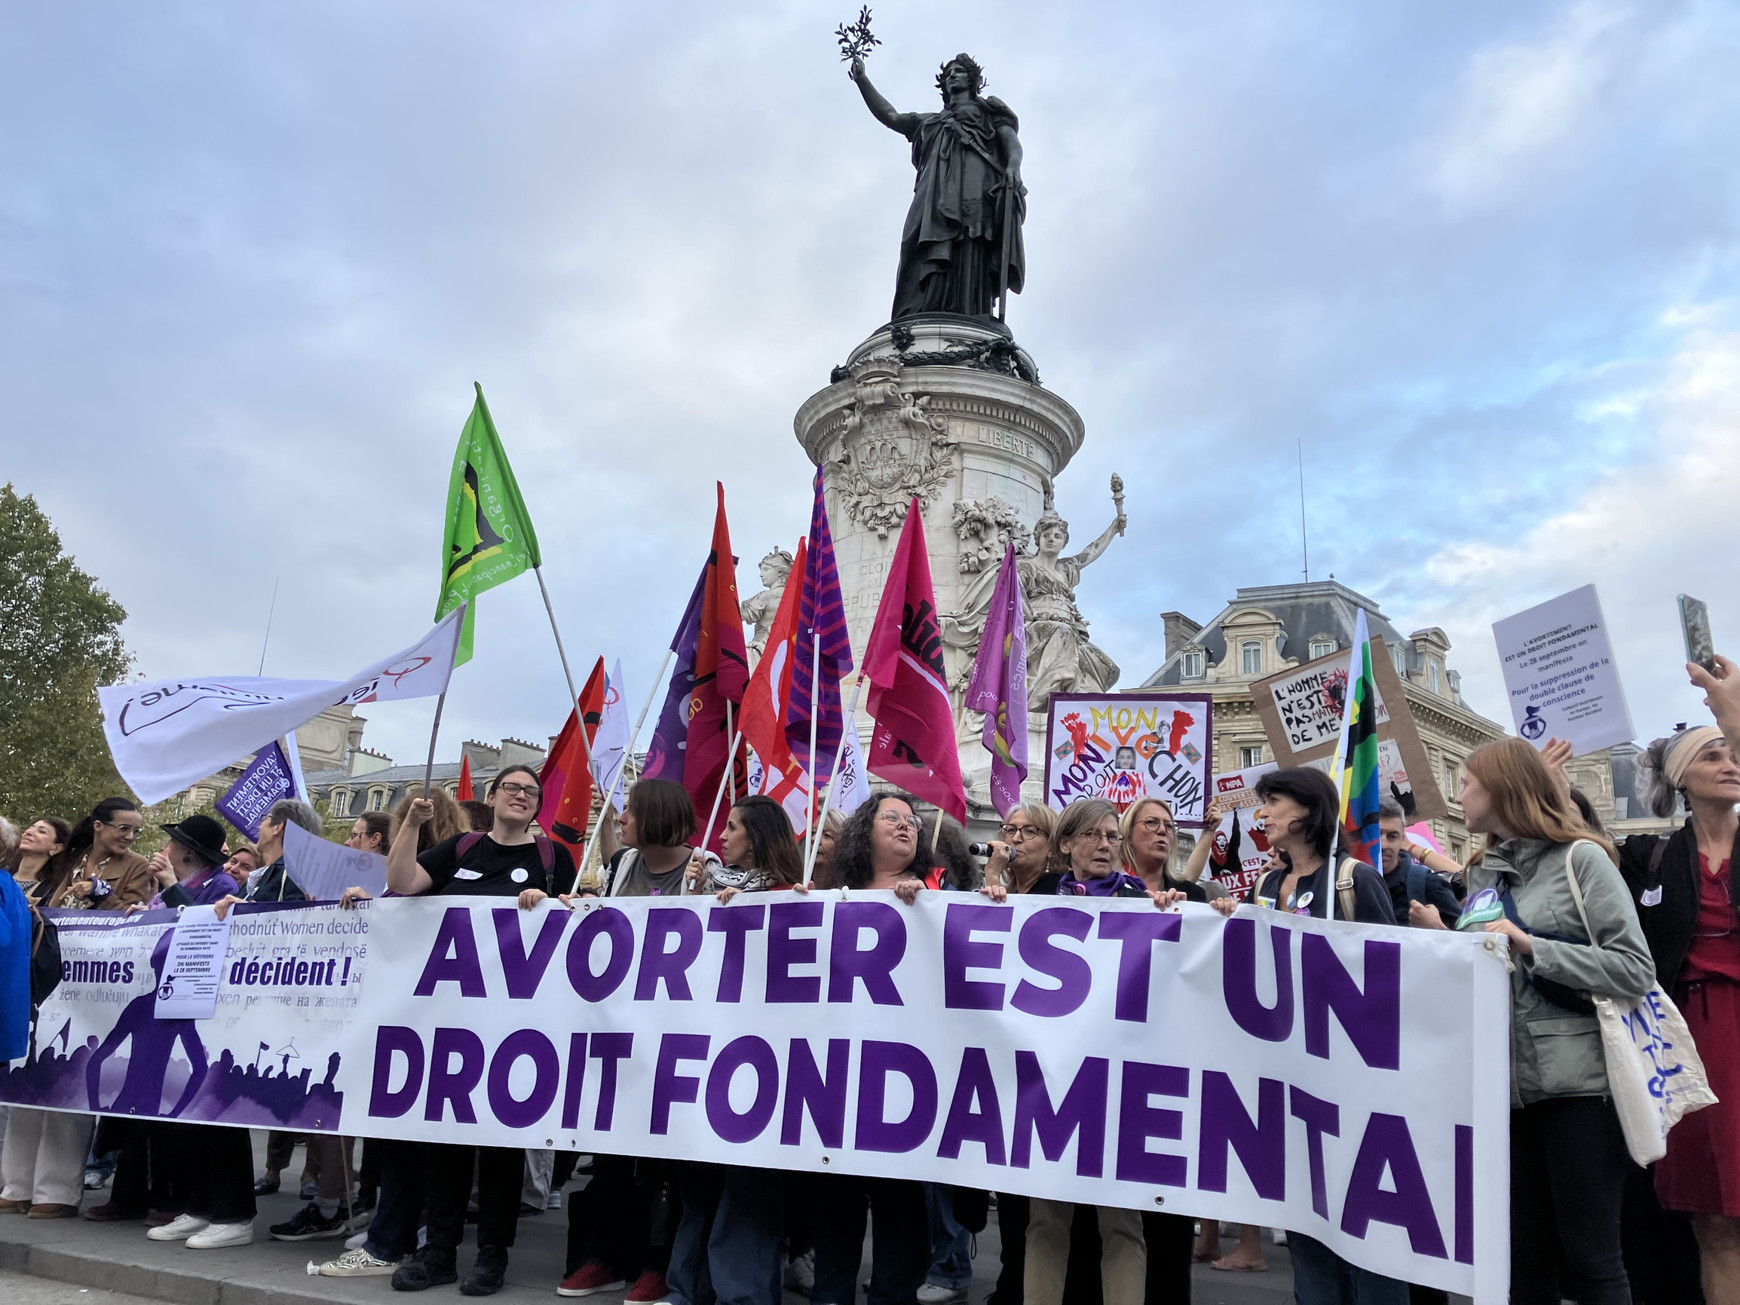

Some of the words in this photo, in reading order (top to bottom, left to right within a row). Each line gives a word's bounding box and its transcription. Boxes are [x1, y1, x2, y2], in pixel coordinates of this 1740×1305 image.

[1504, 654, 1515, 663] EST
[1516, 650, 1526, 658] UN
[1527, 642, 1547, 654] DROIT
[1547, 623, 1599, 647] FONDAMENTAL
[1523, 623, 1572, 647] L'AVORTEMENT
[1528, 657, 1537, 666] 28
[1538, 643, 1577, 662] septembre
[1578, 639, 1588, 647] on
[1538, 655, 1574, 673] manifeste
[1511, 686, 1530, 697] Pour
[1530, 682, 1539, 690] la
[1539, 664, 1588, 687] suppression
[1589, 661, 1600, 670] de
[1600, 657, 1609, 665] la
[1529, 686, 1556, 702] double
[1557, 677, 1583, 691] clause
[1584, 673, 1595, 682] de
[1281, 690, 1323, 717] N'EST
[1542, 687, 1586, 708] conscience
[1089, 704, 1158, 733] MON
[1285, 714, 1313, 730] PAS
[1089, 725, 1160, 760] IVG
[1291, 729, 1313, 745] DE
[1052, 742, 1106, 808] MON
[1148, 750, 1203, 815] CHOIX
[1226, 779, 1243, 789] NPA
[281, 920, 324, 935] Women
[327, 917, 369, 935] decide
[229, 956, 336, 986] décident
[340, 957, 352, 987] !
[413, 901, 908, 1006] AVORTER
[944, 903, 1182, 1024] EST
[1222, 918, 1401, 1071] UN
[368, 1025, 635, 1132] DROIT
